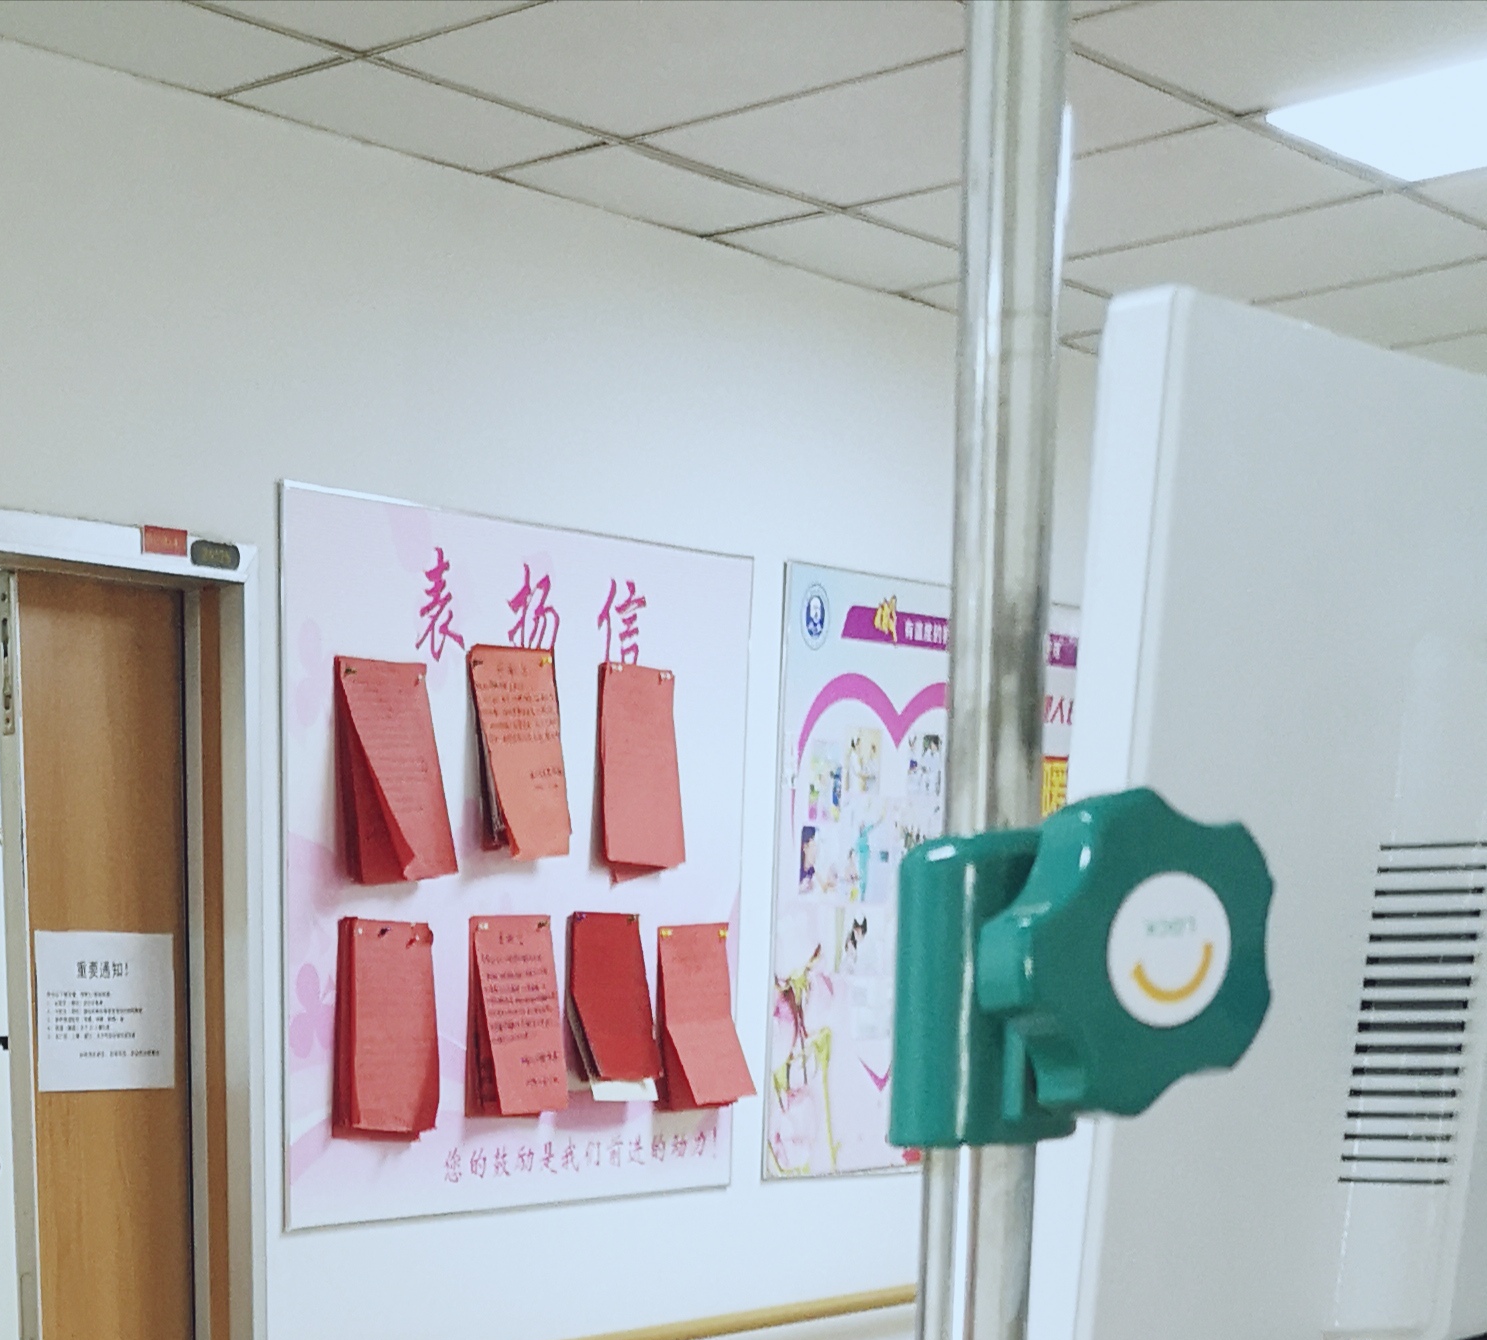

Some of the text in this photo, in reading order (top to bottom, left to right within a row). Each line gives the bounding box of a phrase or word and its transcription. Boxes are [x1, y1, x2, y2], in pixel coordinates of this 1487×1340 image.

[415, 546, 646, 664] 表扬信
[76, 960, 130, 980] 重要通知!
